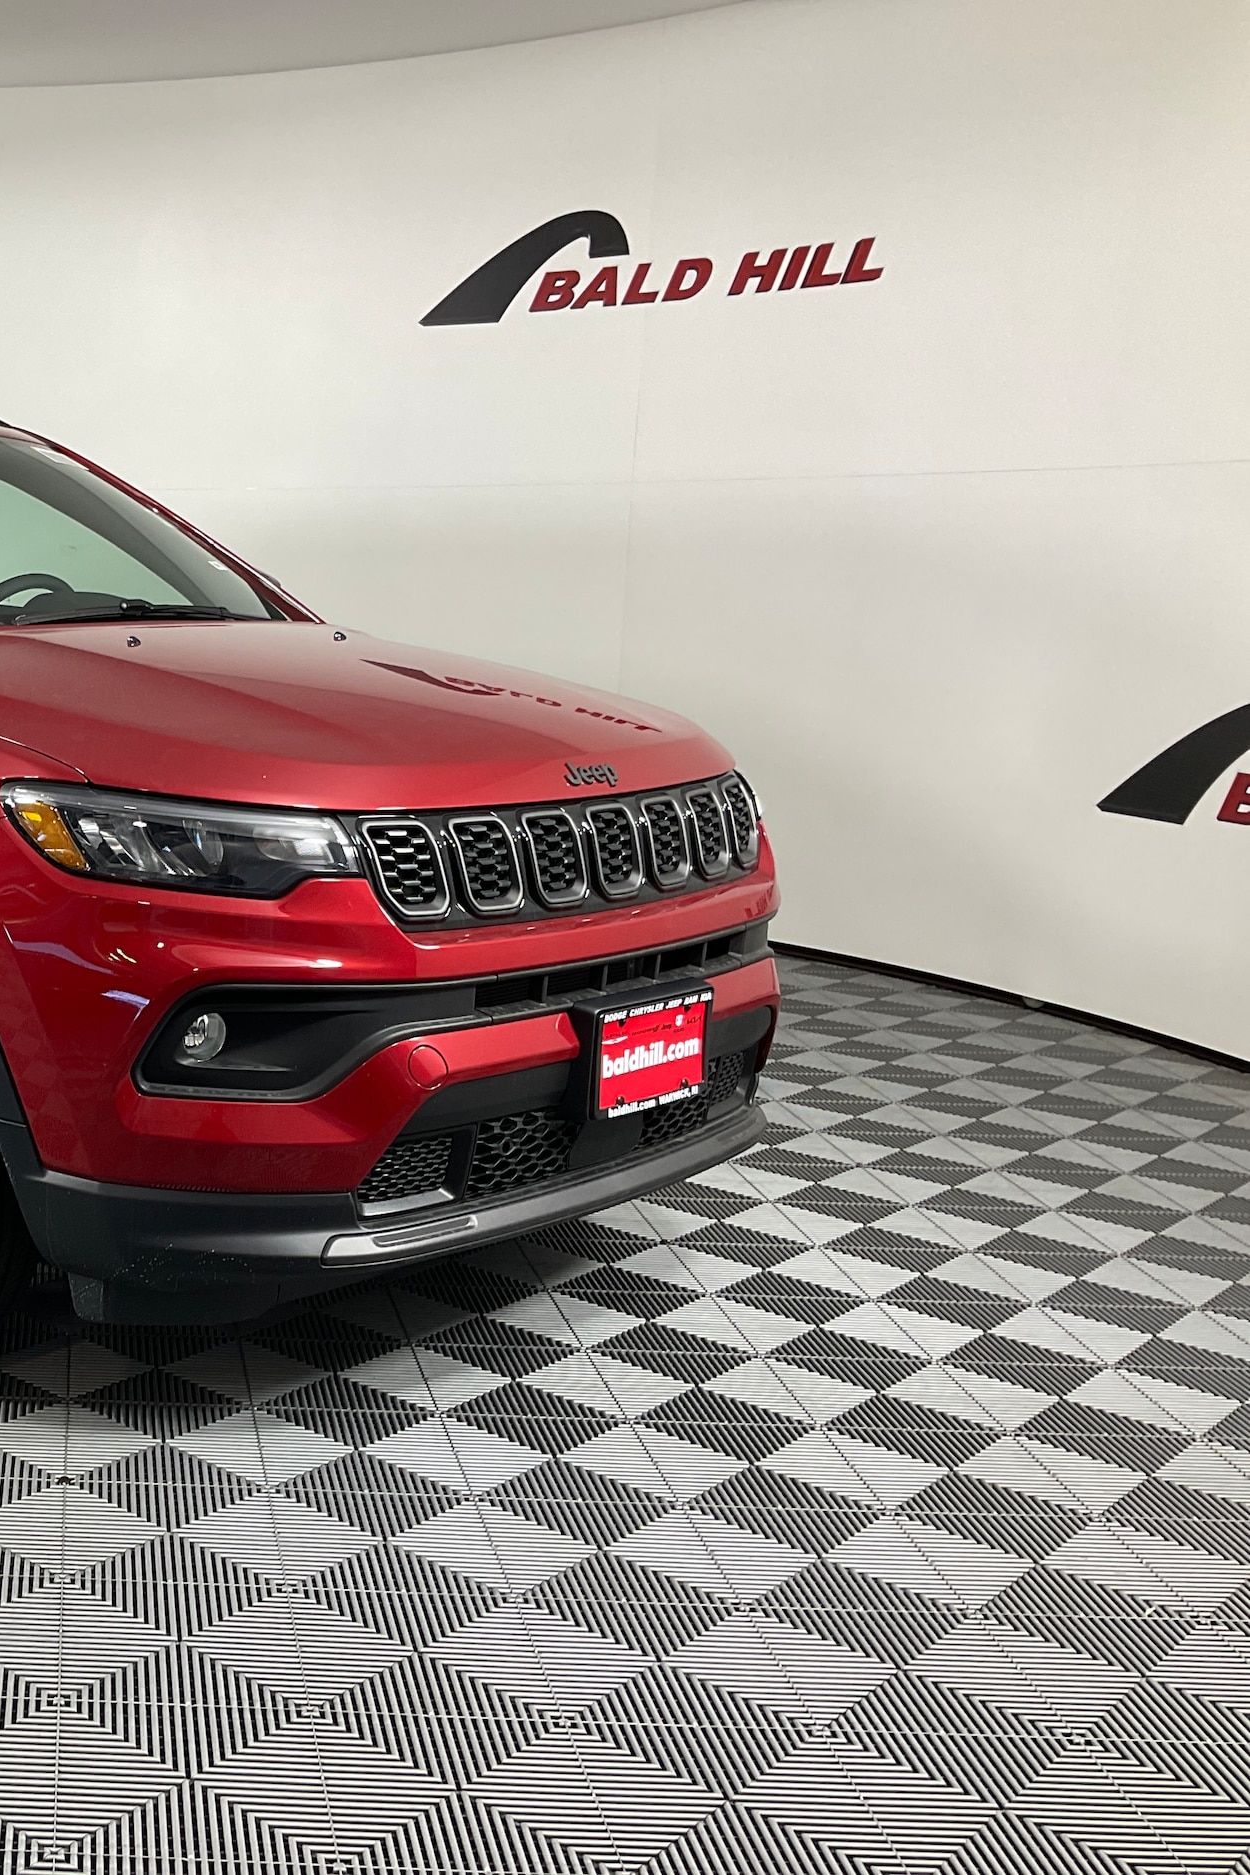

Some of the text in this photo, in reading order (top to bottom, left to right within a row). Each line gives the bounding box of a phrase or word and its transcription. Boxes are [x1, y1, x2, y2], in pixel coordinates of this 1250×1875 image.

[529, 236, 885, 313] BALD HILL
[564, 762, 619, 787] Jeep
[604, 991, 713, 1023] DODGE CHRYSLER JEEP RAM KIA
[602, 1037, 700, 1079] baldhill.com
[608, 1099, 656, 1118] baldhill.com
